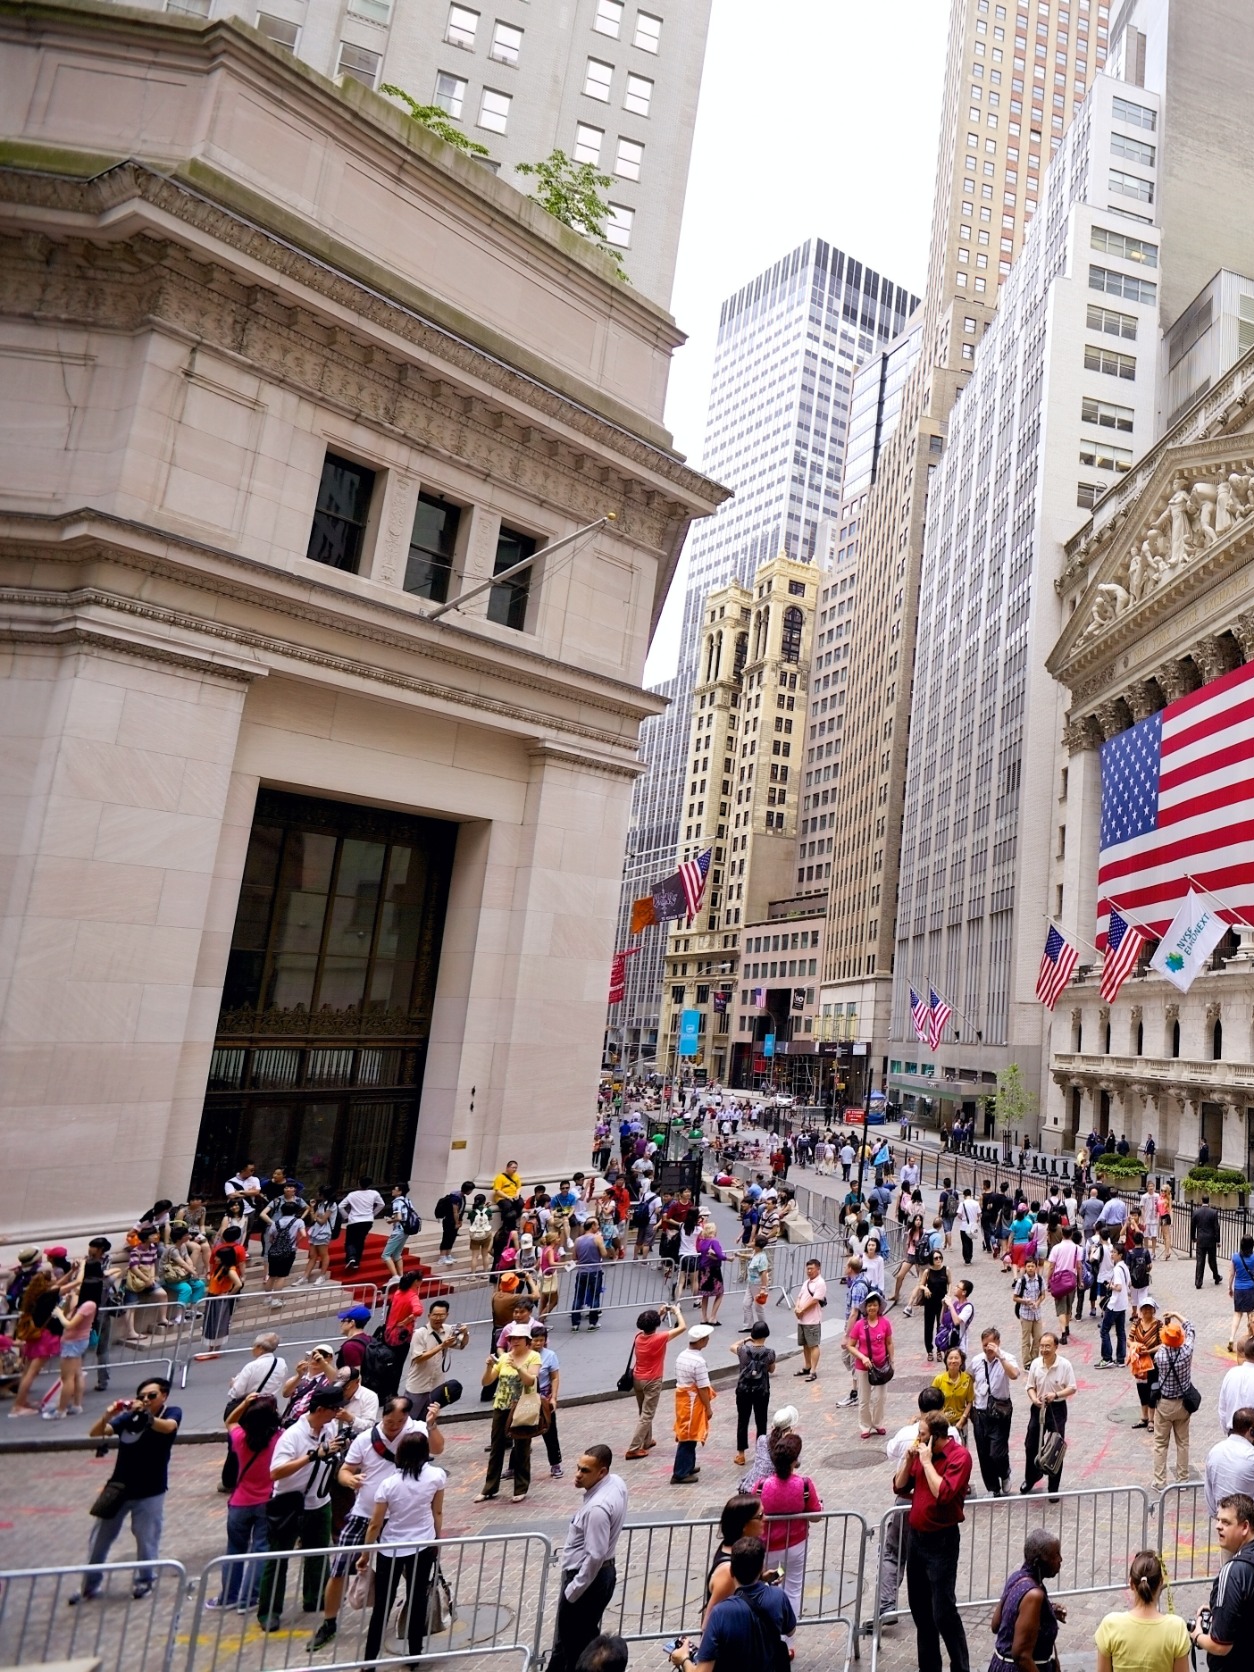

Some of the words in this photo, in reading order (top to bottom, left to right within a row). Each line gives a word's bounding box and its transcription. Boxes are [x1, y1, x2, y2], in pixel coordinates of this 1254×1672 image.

[1175, 610, 1199, 634] STOCK
[1204, 575, 1248, 613] EXCHANGE
[1176, 926, 1192, 950] NYSE
